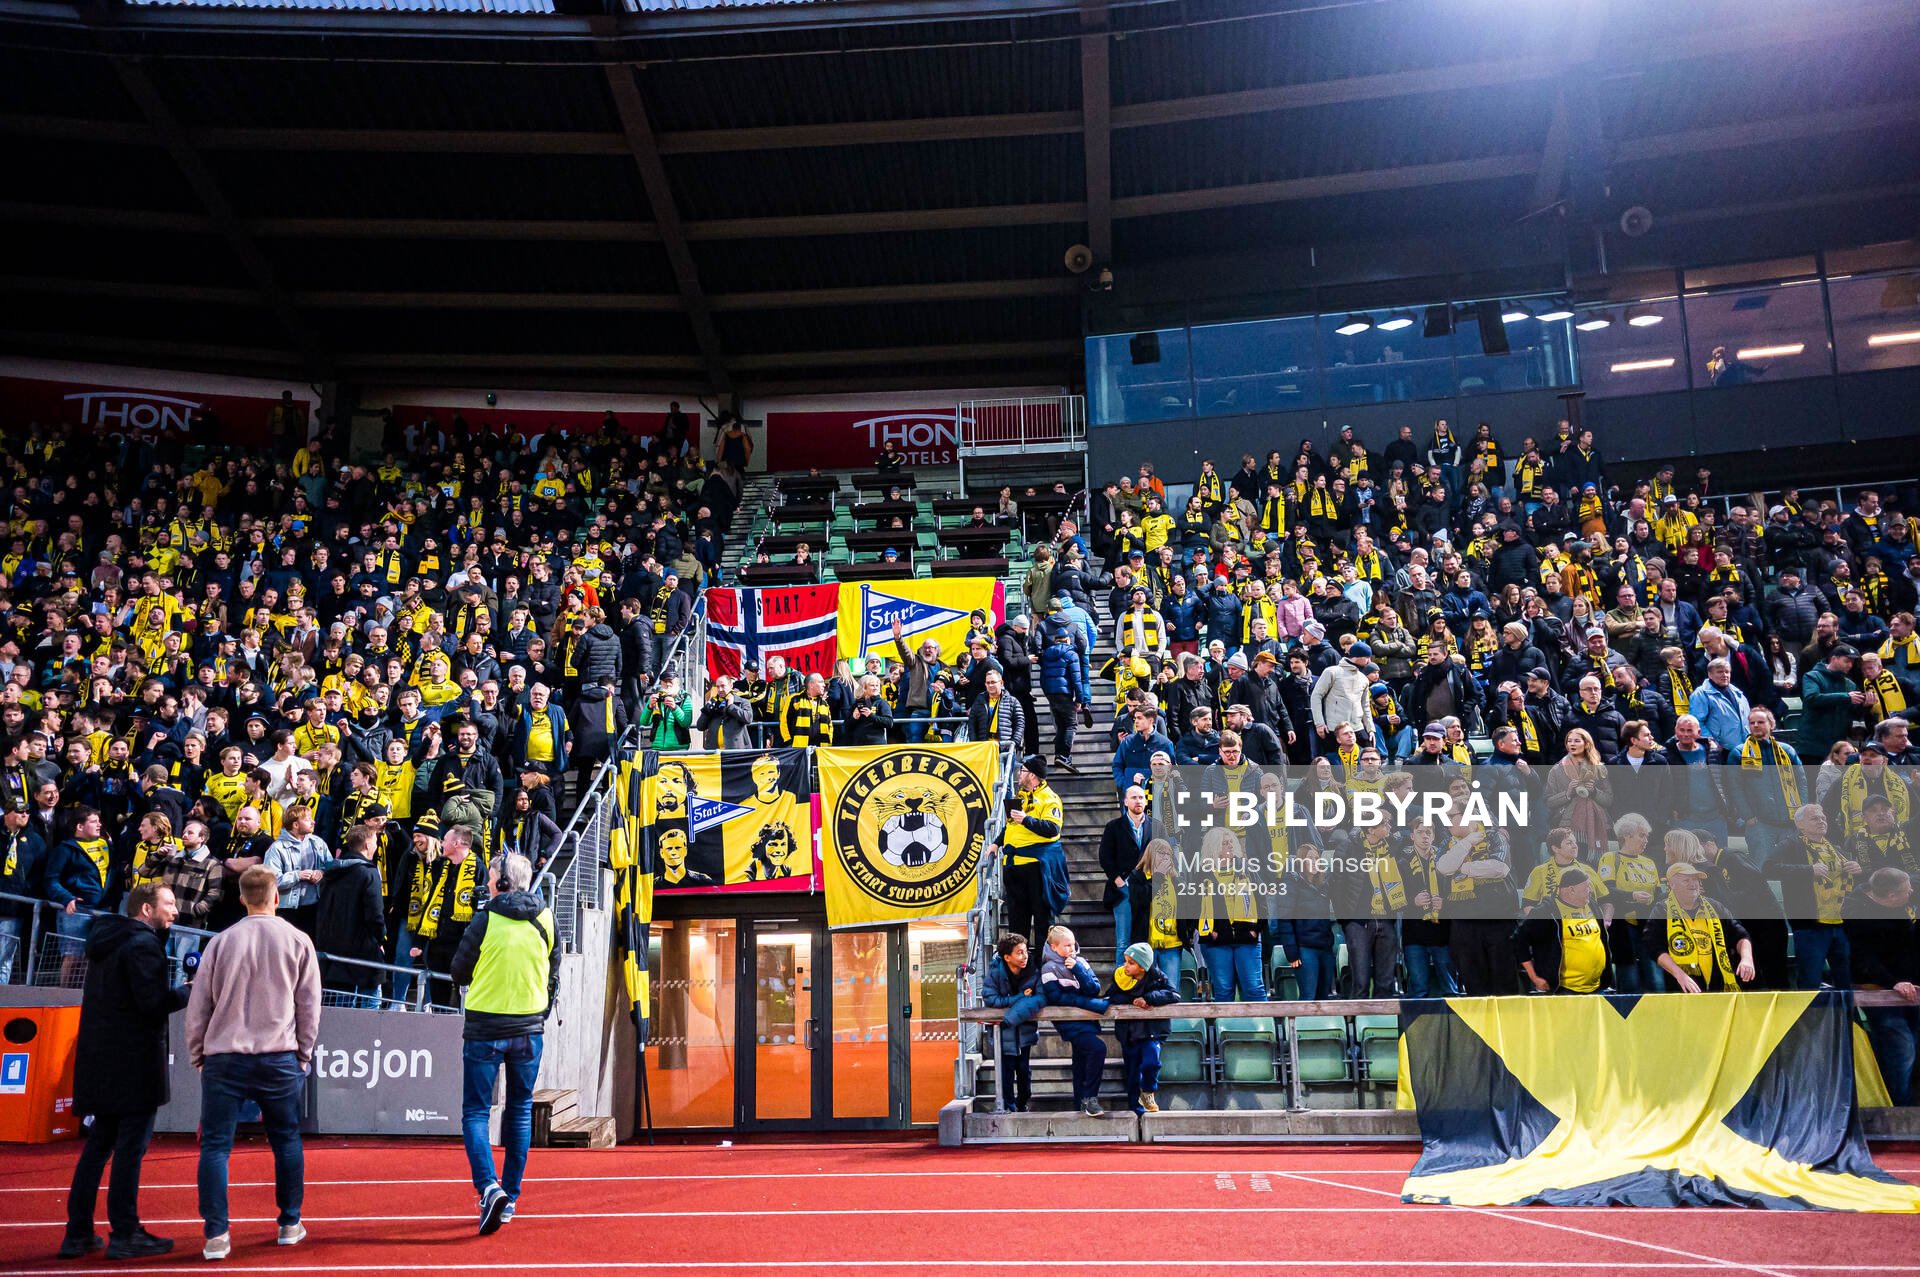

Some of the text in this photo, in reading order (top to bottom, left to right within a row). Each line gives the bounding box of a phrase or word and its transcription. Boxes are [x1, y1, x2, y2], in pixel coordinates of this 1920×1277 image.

[64, 392, 200, 432] THON
[853, 413, 976, 448] THON
[896, 451, 950, 465] OTELS
[757, 593, 799, 616] START
[869, 603, 925, 629] Start
[841, 755, 983, 821] TIGERBERGET
[694, 802, 728, 821] Start
[843, 833, 985, 900] IK START SUPPORTERKLUBB
[314, 1039, 433, 1088] tasjon
